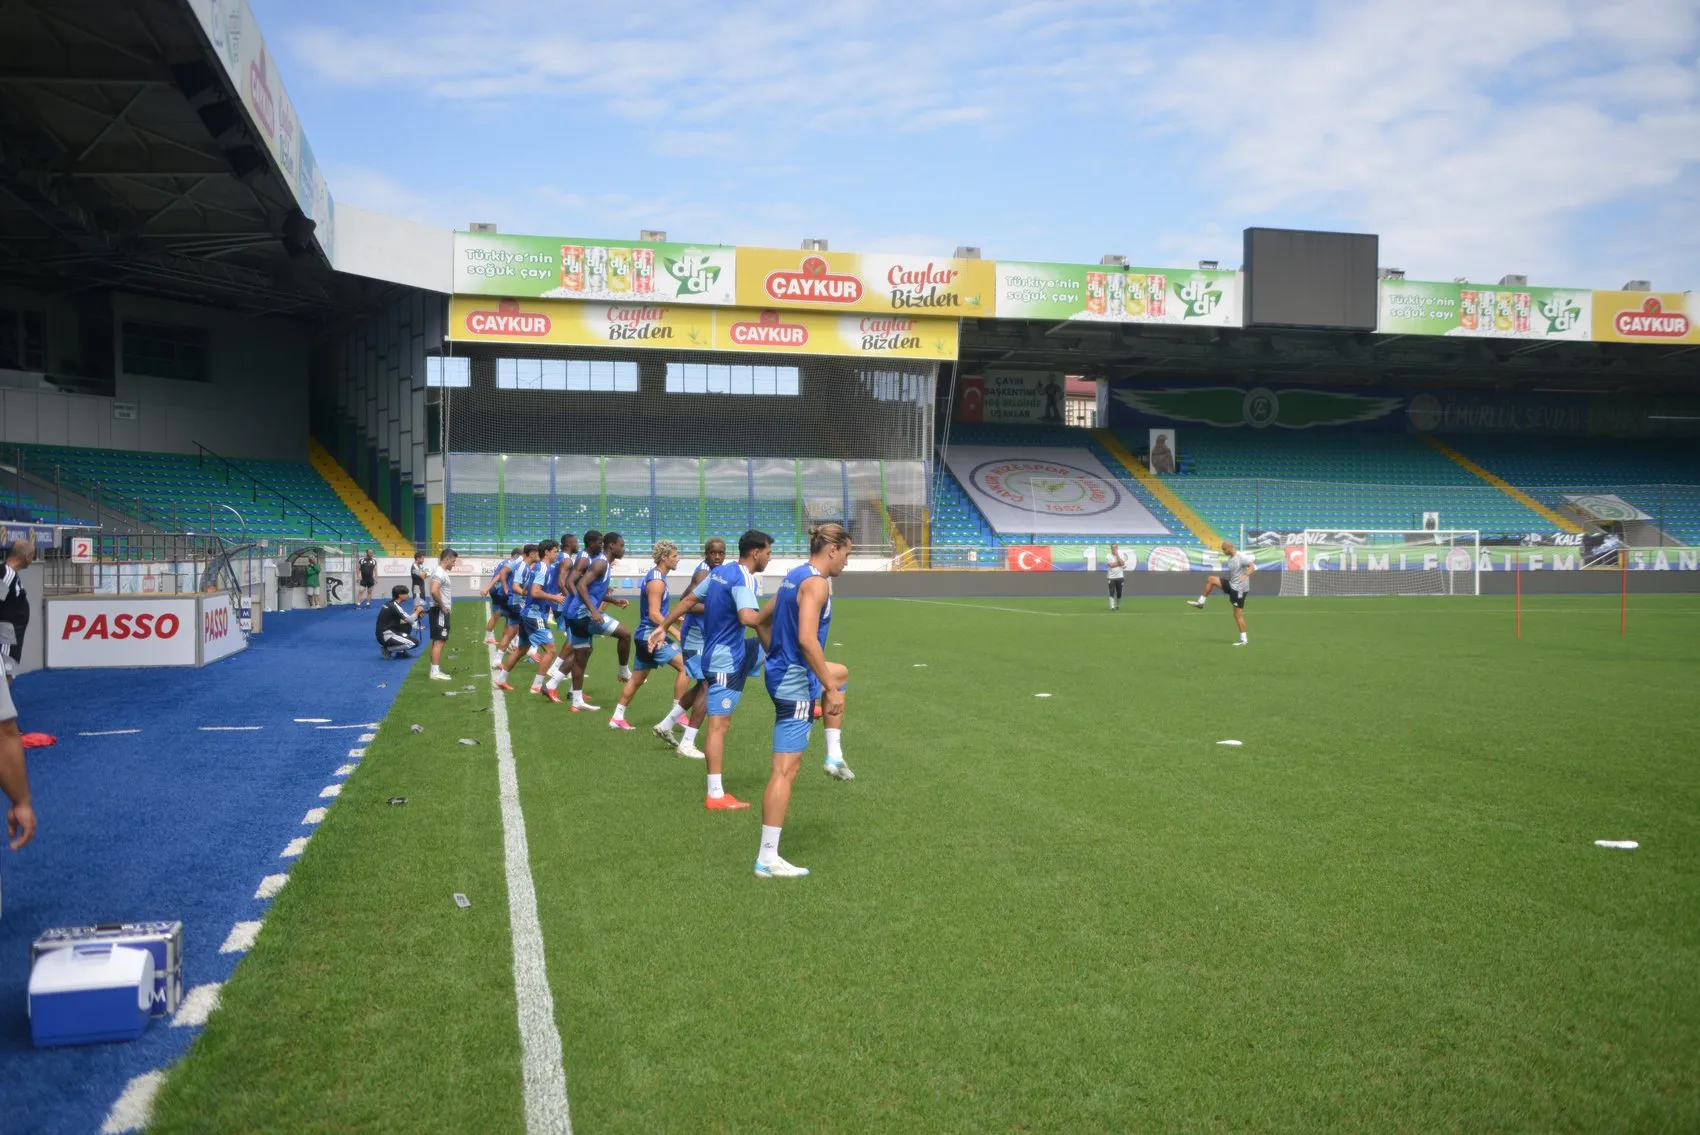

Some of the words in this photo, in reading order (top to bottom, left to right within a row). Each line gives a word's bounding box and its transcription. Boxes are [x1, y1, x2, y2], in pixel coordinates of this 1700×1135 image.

[467, 264, 513, 278] soğuk
[520, 266, 552, 279] çayı
[887, 262, 959, 293] Çaylar
[772, 277, 857, 298] ÇAYKUR
[1005, 289, 1046, 303] soğuk
[1052, 292, 1079, 304] çayı
[891, 289, 961, 310] Bizden
[1391, 306, 1426, 319] soğuk
[1430, 309, 1453, 321] çayı
[472, 315, 546, 334] ÇAYKUR
[608, 323, 674, 341] Bizden
[1619, 316, 1686, 335] ÇAYKUR
[735, 325, 804, 344] ÇAYKUR
[861, 333, 922, 351] Bizden
[1286, 532, 1328, 546] DENİZ
[1554, 533, 1585, 546] KALE
[77, 543, 88, 558] 2
[62, 613, 180, 641] PASSO
[204, 606, 229, 643] PASSO
